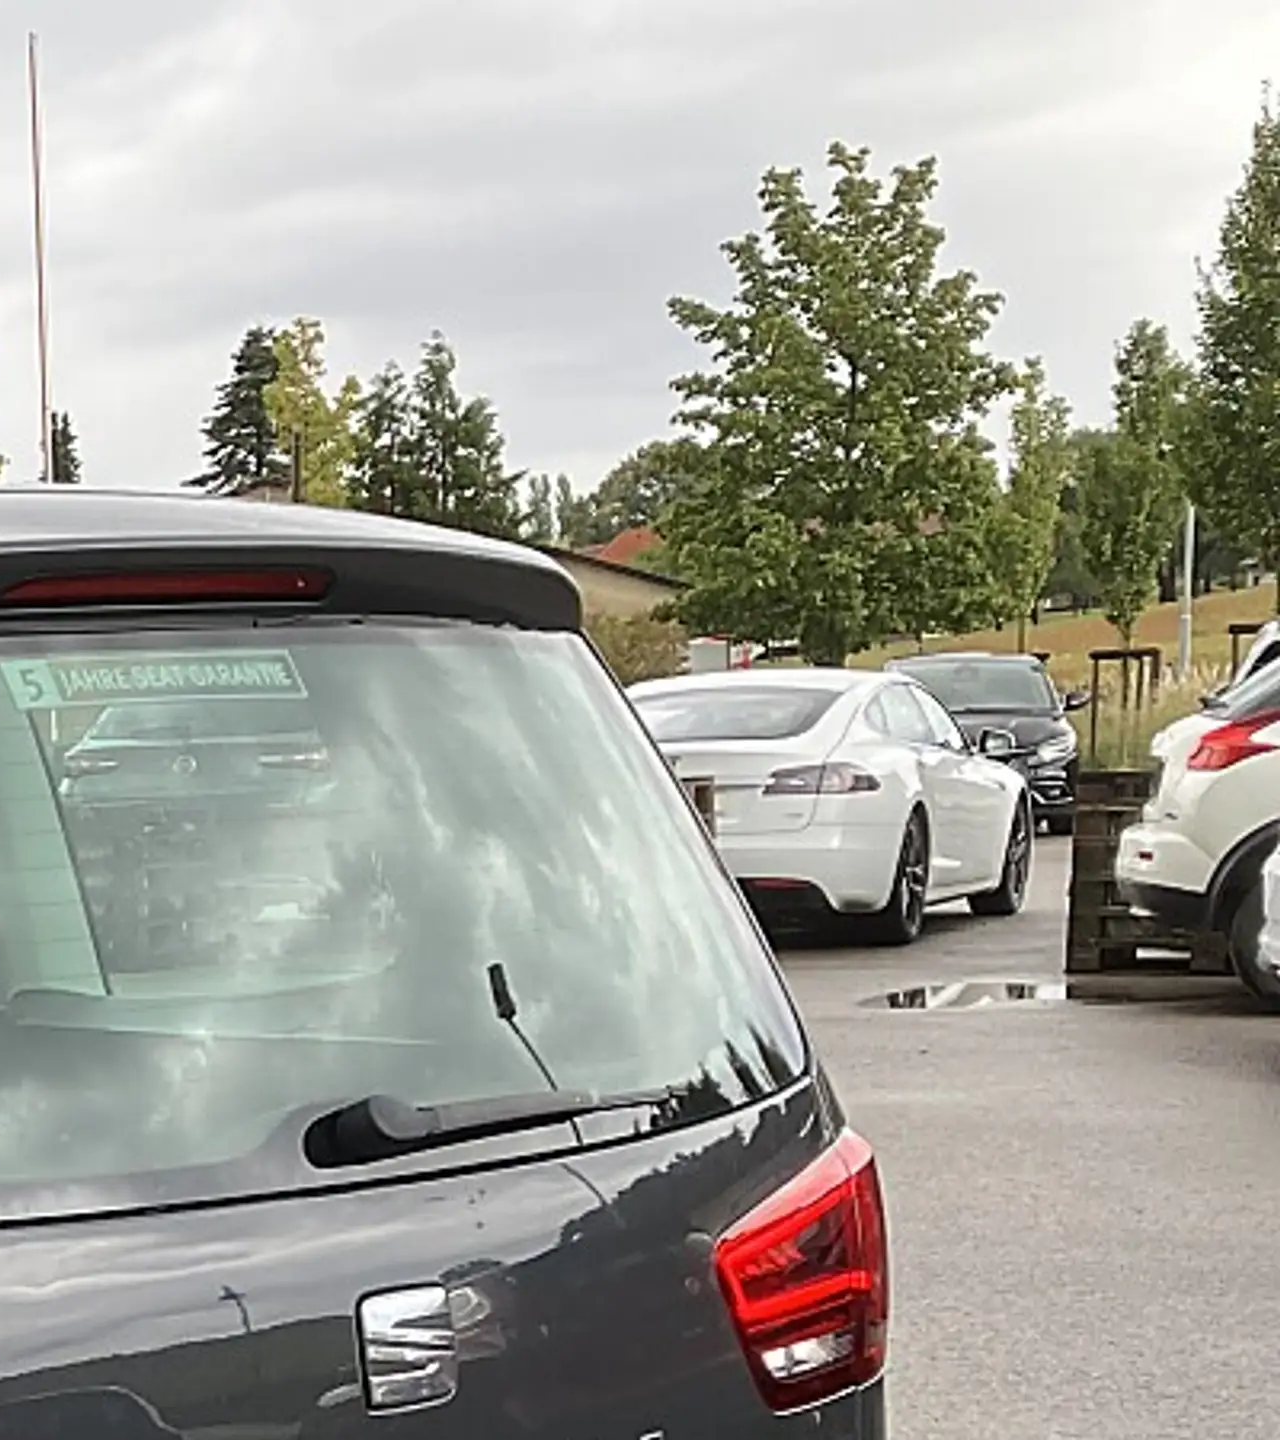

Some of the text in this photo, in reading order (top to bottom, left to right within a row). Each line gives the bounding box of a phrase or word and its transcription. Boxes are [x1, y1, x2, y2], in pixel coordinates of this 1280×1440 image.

[18, 661, 293, 703] 5 JAHRE SEAT GARANTIE
